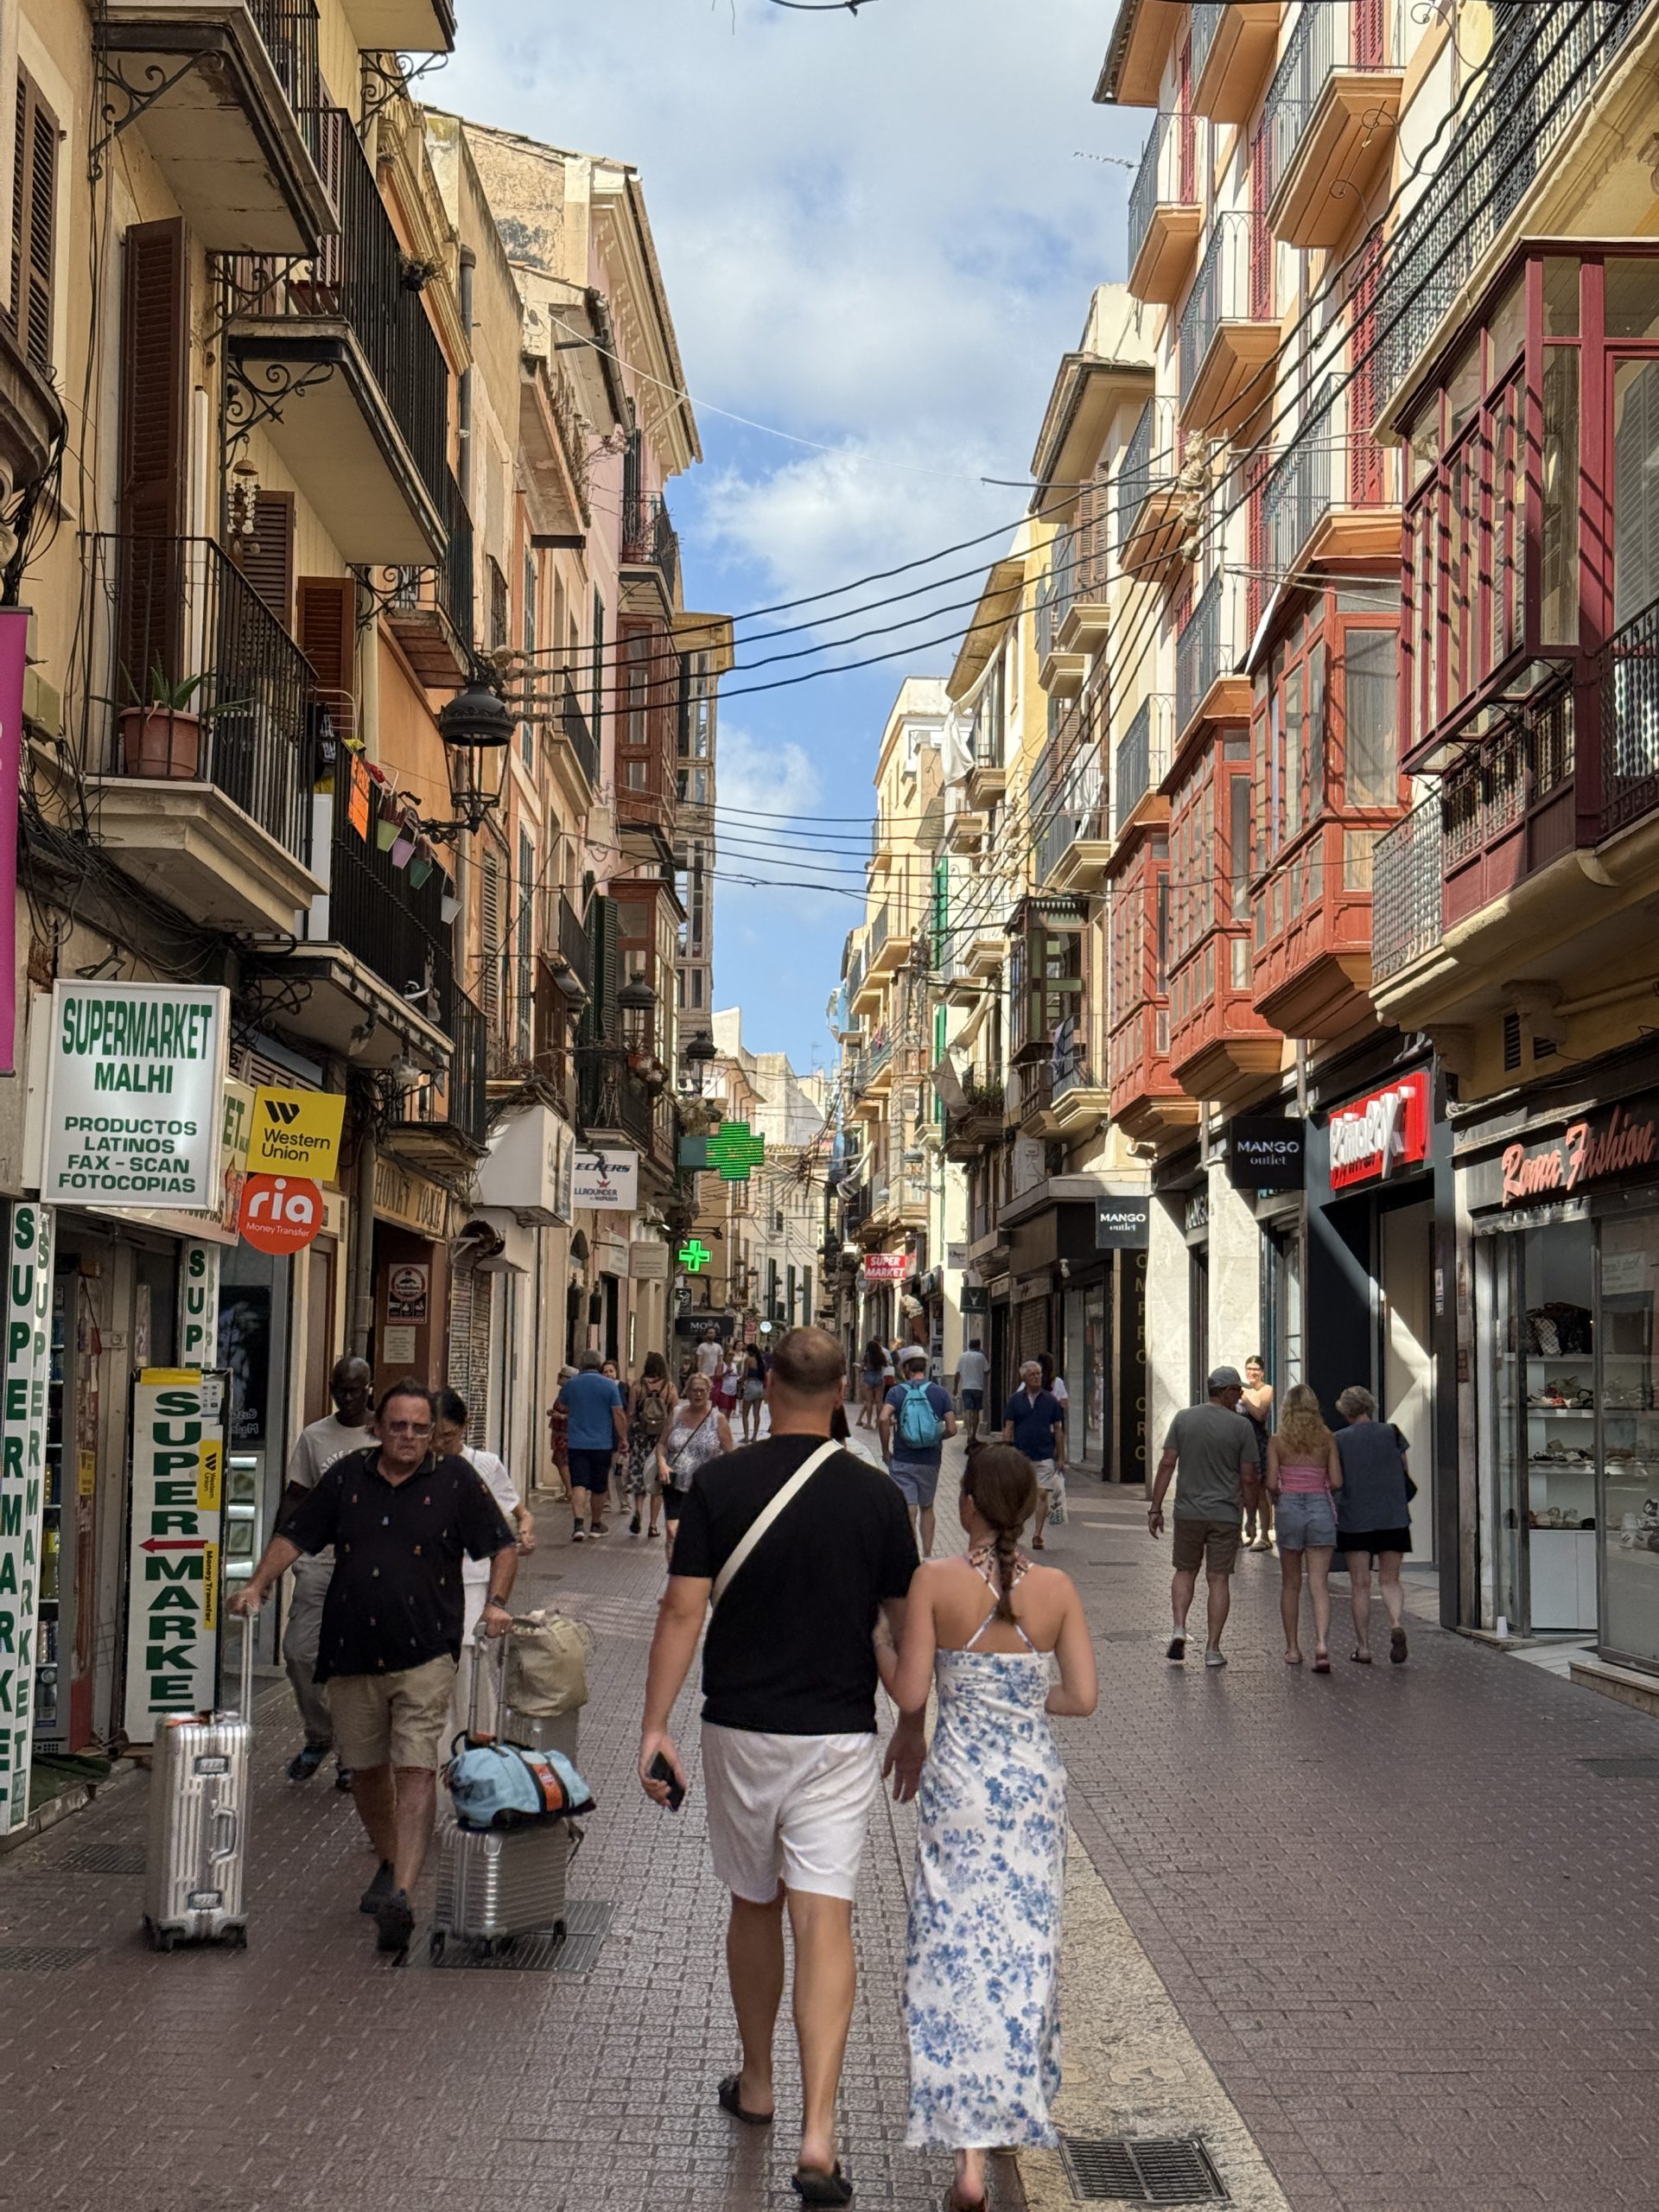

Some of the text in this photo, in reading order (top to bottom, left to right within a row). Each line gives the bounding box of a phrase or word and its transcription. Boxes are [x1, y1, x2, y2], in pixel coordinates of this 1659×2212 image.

[62, 998, 213, 1060] SUPERMARKET
[94, 1062, 173, 1094] MALHI
[64, 1116, 197, 1136] PRODUCTOS
[84, 1136, 175, 1154] LATINOS
[264, 1127, 331, 1150] Western
[1237, 1141, 1300, 1154] MANGO
[261, 1142, 309, 1162] Union
[1249, 1154, 1287, 1166] outlet
[67, 1154, 111, 1171] FAX
[130, 1157, 190, 1174] SCAN
[58, 1173, 195, 1193] FOTOCOPIAS
[574, 1187, 618, 1197] LLROUNDER
[248, 1178, 314, 1224] ria
[1100, 1213, 1146, 1223] MANGO
[1109, 1222, 1136, 1231] outlet
[246, 1221, 310, 1238] Money Transfer
[869, 1256, 901, 1267] SUPER
[865, 1267, 906, 1277] MARKET
[185, 1249, 206, 1368] SUP
[152, 1391, 202, 1535] SUPER
[204, 1550, 213, 1623] Money Transfer
